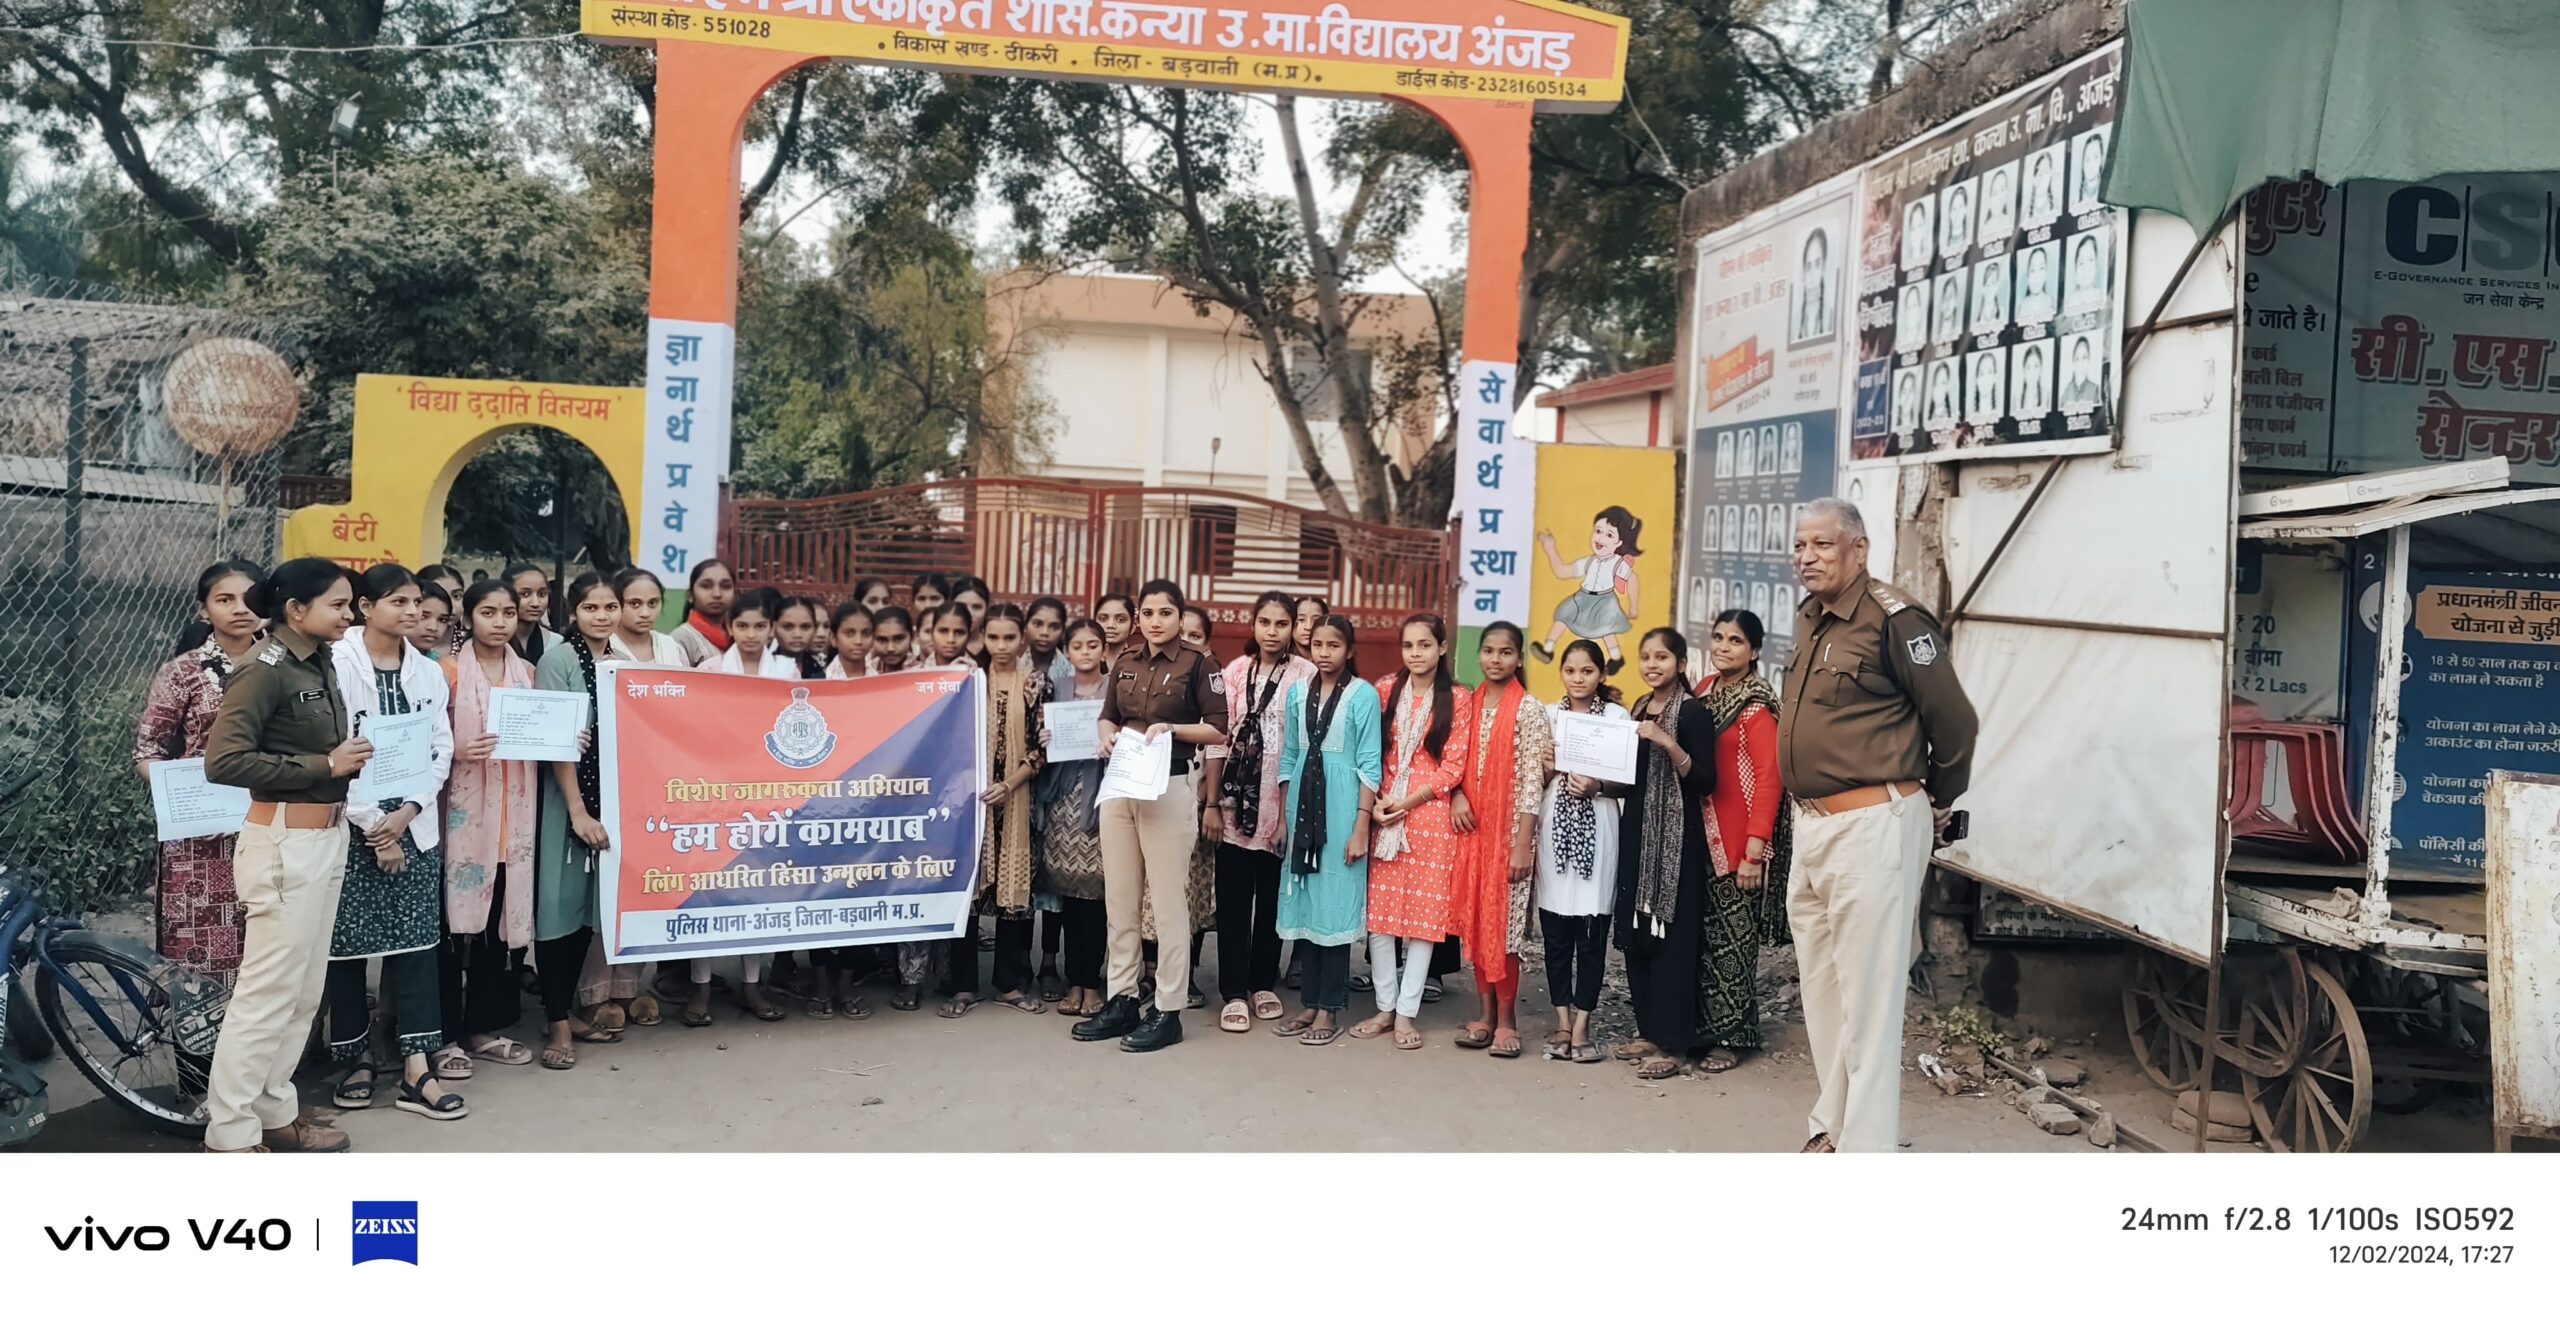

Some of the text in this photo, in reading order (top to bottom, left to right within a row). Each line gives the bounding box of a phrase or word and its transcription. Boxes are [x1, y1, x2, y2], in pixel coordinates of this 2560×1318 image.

[611, 5, 657, 27] संस्था
[703, 17, 770, 38] 551028
[893, 31, 949, 54] विकास
[955, 41, 990, 57] खण्ड
[1004, 41, 1058, 64] ठीकरी
[1467, 14, 1575, 77] अंजड़
[1094, 46, 1141, 71] जिला
[1161, 56, 1239, 78] बड़वानी
[1397, 69, 1437, 90] डाईस
[1973, 122, 2008, 157] कन्या
[2076, 72, 2115, 111] अंजड़
[2463, 291, 2546, 311] जन सेवा केन्द्र
[2258, 303, 2298, 330] जाते
[2251, 343, 2278, 362] कार्ड
[2275, 368, 2304, 388] बिल
[467, 386, 531, 420] ददाति
[2275, 391, 2325, 412] पंजीयन
[2267, 415, 2297, 434] फार्म
[2278, 440, 2307, 458] फार्म
[332, 512, 378, 542] बेटी
[2437, 589, 2518, 610] प्रधानमंत्री
[2252, 615, 2276, 635] 20
[2450, 612, 2506, 634] योजना
[2508, 615, 2525, 635] से
[2244, 641, 2283, 667] बीमा
[2431, 653, 2551, 672] 18 से 50 साल तक का
[626, 679, 687, 700] देश भक्ति
[915, 676, 961, 695] जन सेवा
[2255, 677, 2265, 692] 2
[2270, 678, 2307, 694] Lacs
[2428, 672, 2545, 689] का लाभ ले सकता है
[2426, 716, 2469, 732] योजना
[2472, 722, 2489, 733] का
[2492, 722, 2520, 735] लाभ
[2523, 720, 2546, 736] लेने
[2425, 735, 2472, 749] अकाउंट
[2474, 739, 2492, 750] का
[2495, 736, 2524, 751] होना
[664, 777, 729, 803] विशेष
[848, 774, 932, 798] अभियान
[2422, 773, 2466, 788] योजना
[2422, 789, 2466, 806] चेकअप
[2419, 835, 2485, 852] पॉलिसी की
[641, 865, 686, 895] लिंग
[767, 859, 818, 886] हिंसा
[820, 862, 888, 889] उन्मूलन
[888, 855, 912, 879] के
[914, 854, 956, 879] लिए
[665, 913, 709, 943] पुलिस
